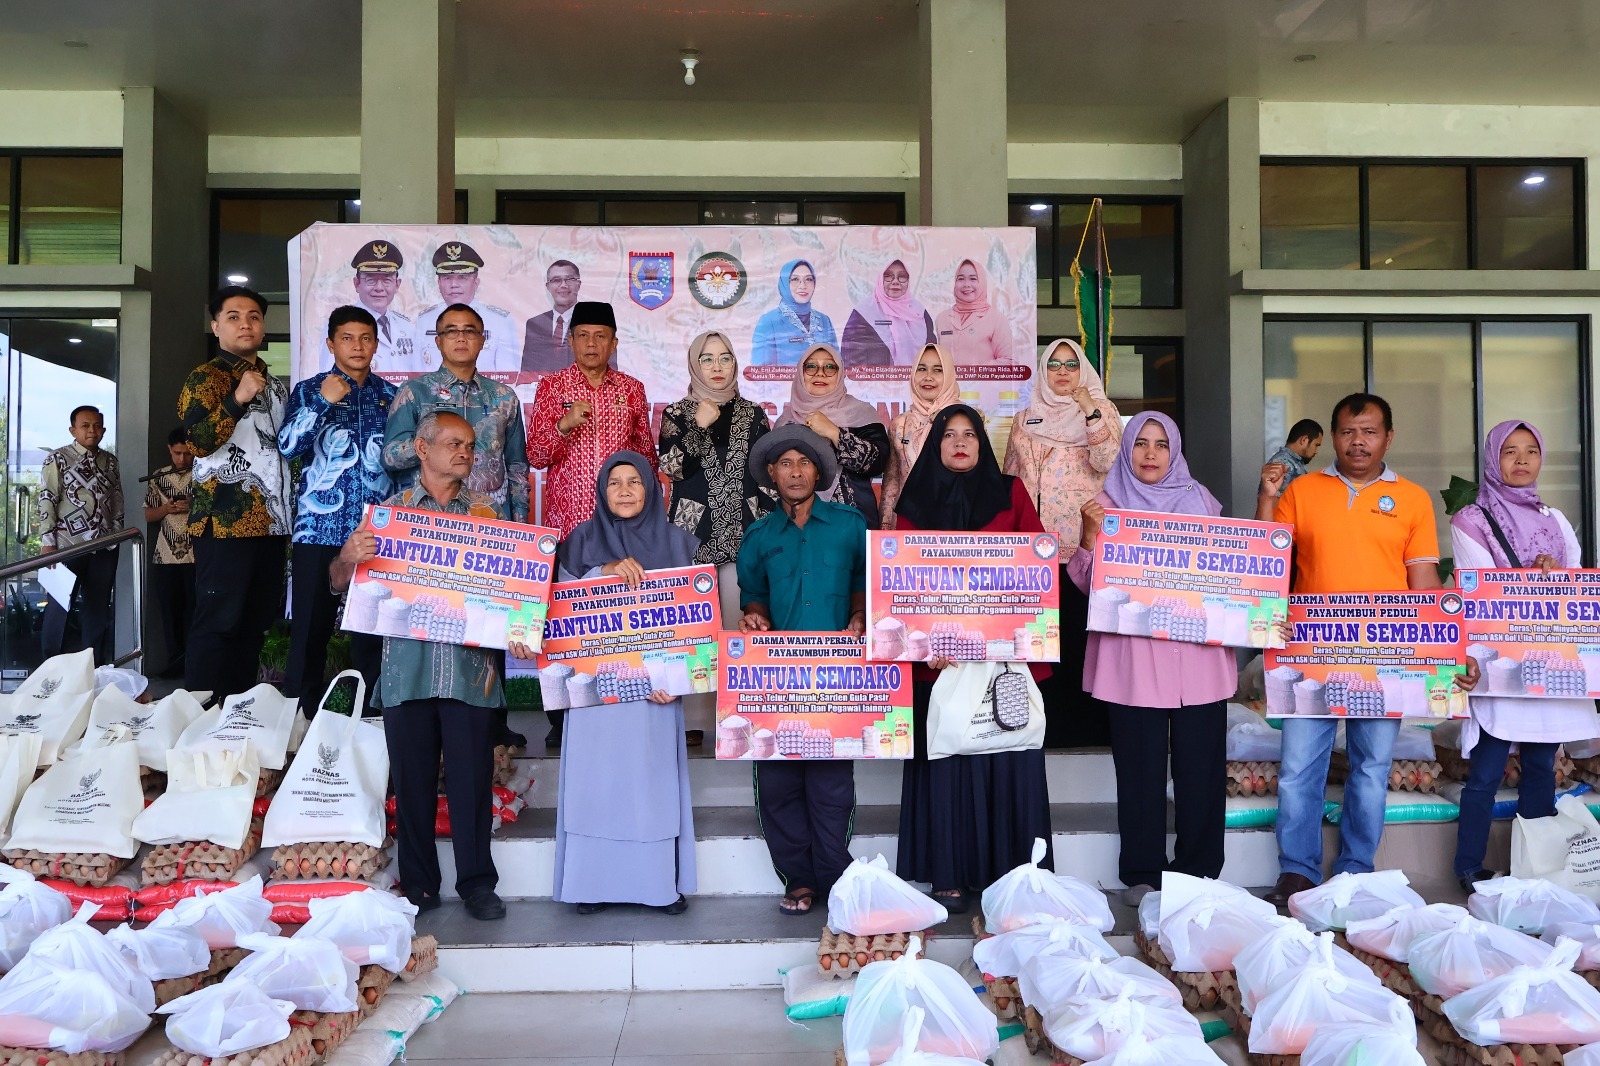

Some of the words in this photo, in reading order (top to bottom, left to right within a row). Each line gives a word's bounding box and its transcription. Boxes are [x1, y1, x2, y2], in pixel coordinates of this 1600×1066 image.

[396, 512, 431, 526] DARMA
[435, 518, 474, 532] WANITA
[478, 525, 535, 542] PERSATUAN
[1126, 519, 1159, 529] DARMA
[1164, 522, 1204, 533] WANITA
[1208, 525, 1266, 538] PERSATUAN
[410, 528, 477, 546] PAYAKUMBUH
[481, 539, 516, 552] PEDULI
[1141, 533, 1208, 546] PAYAKUMBUH
[1212, 538, 1248, 549] PEDULI
[922, 549, 982, 557] PAYAKUMBUH
[1103, 544, 1190, 568] BANTUAN
[1197, 551, 1284, 576] SEMBAKO
[463, 551, 549, 581] SEMBAKO
[488, 578, 505, 587] Pasir
[881, 567, 964, 591] BANTUAN
[969, 567, 1052, 591] SEMBAKO
[1208, 575, 1222, 584] Gula
[1224, 577, 1241, 585] Pasir
[1484, 573, 1522, 581] DARMA
[554, 588, 587, 600] DARMA
[591, 584, 630, 595] WANITA
[634, 577, 689, 590] ERSATUAN
[1503, 586, 1576, 595] PAYAKUMBUH
[572, 596, 636, 611] PAYAKUMBUH
[640, 592, 674, 603] PEDULI
[973, 595, 1000, 603] Sarden
[1290, 596, 1324, 604] DARMA
[1328, 596, 1370, 604] WANITA
[1374, 596, 1435, 604] PERSATUAN
[1307, 609, 1376, 617] PAYAKUMBUH
[1380, 609, 1417, 617] PEDULI
[1464, 601, 1559, 620] BANTUAN
[544, 612, 622, 639] BANTUAN
[629, 603, 713, 629] SEMBAKO
[644, 632, 657, 640] Gula
[1367, 624, 1459, 642] SEMBAKO
[752, 637, 785, 645] DARMA
[787, 637, 823, 645] WANITA
[768, 649, 830, 657] PAYAKUMBUH
[832, 649, 861, 657] PEDULI
[1380, 647, 1395, 655] Gula
[1397, 647, 1414, 655] Pasir
[728, 666, 812, 689] BANTUAN
[816, 666, 900, 689] SEMBAKO
[312, 768, 339, 777] BAZNAS
[1570, 837, 1597, 848] AZNAS
